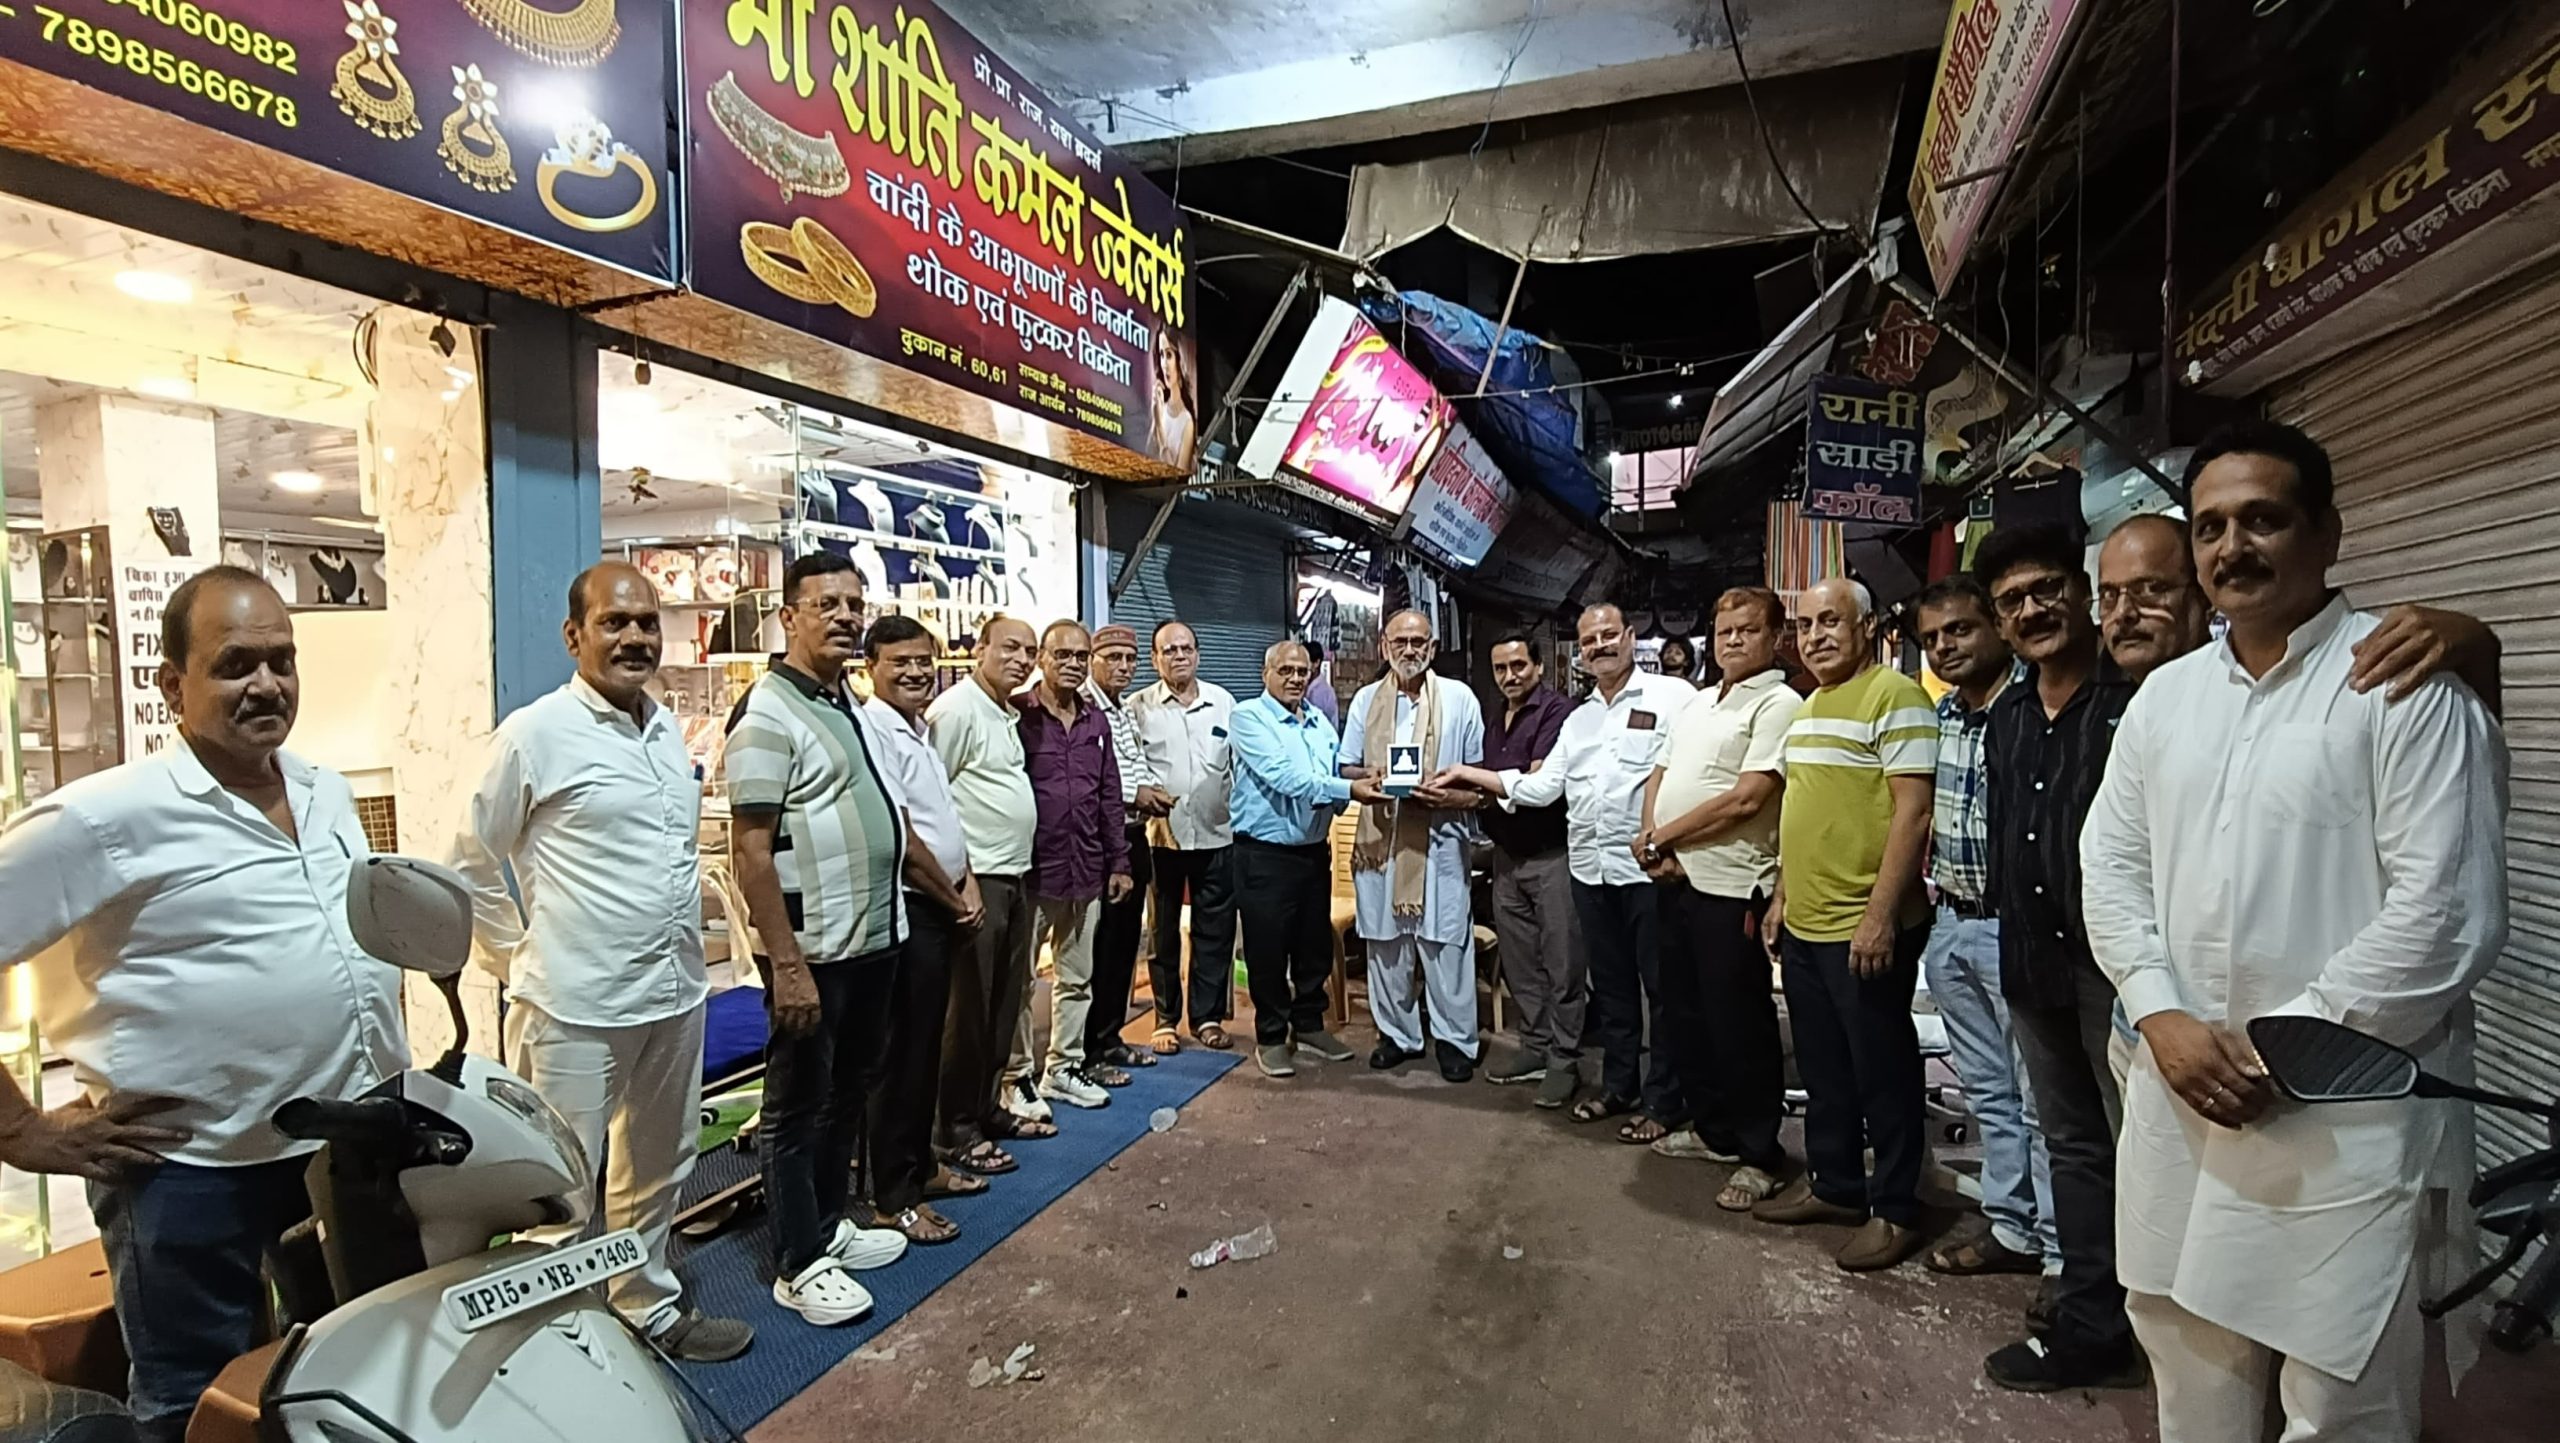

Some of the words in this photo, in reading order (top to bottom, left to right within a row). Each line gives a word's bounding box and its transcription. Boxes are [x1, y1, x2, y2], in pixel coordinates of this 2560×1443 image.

[34, 5, 298, 127] 7898566678
[830, 4, 963, 189] शांति
[970, 110, 1085, 267] कमल
[1089, 175, 1185, 329] ज्वेलर्स
[865, 168, 932, 234] चांदी
[936, 202, 963, 248] के
[968, 228, 1067, 307] आभूषणों
[1068, 278, 1088, 317] के
[1090, 286, 1150, 352] निर्माता
[906, 248, 969, 307] थोक
[973, 284, 1007, 328] एवं
[1010, 301, 1074, 361] फुटकर
[1077, 326, 1132, 387] विक्रेता
[899, 326, 946, 361] दुकान
[970, 357, 1008, 386] 60,61
[1017, 383, 1037, 403] राज
[1818, 391, 1920, 430] रानी
[1816, 439, 1916, 478] साड़ी
[135, 702, 153, 725] NO
[458, 1279, 520, 1321] MP15
[543, 1263, 576, 1291] NB
[595, 1238, 639, 1270] 7409
